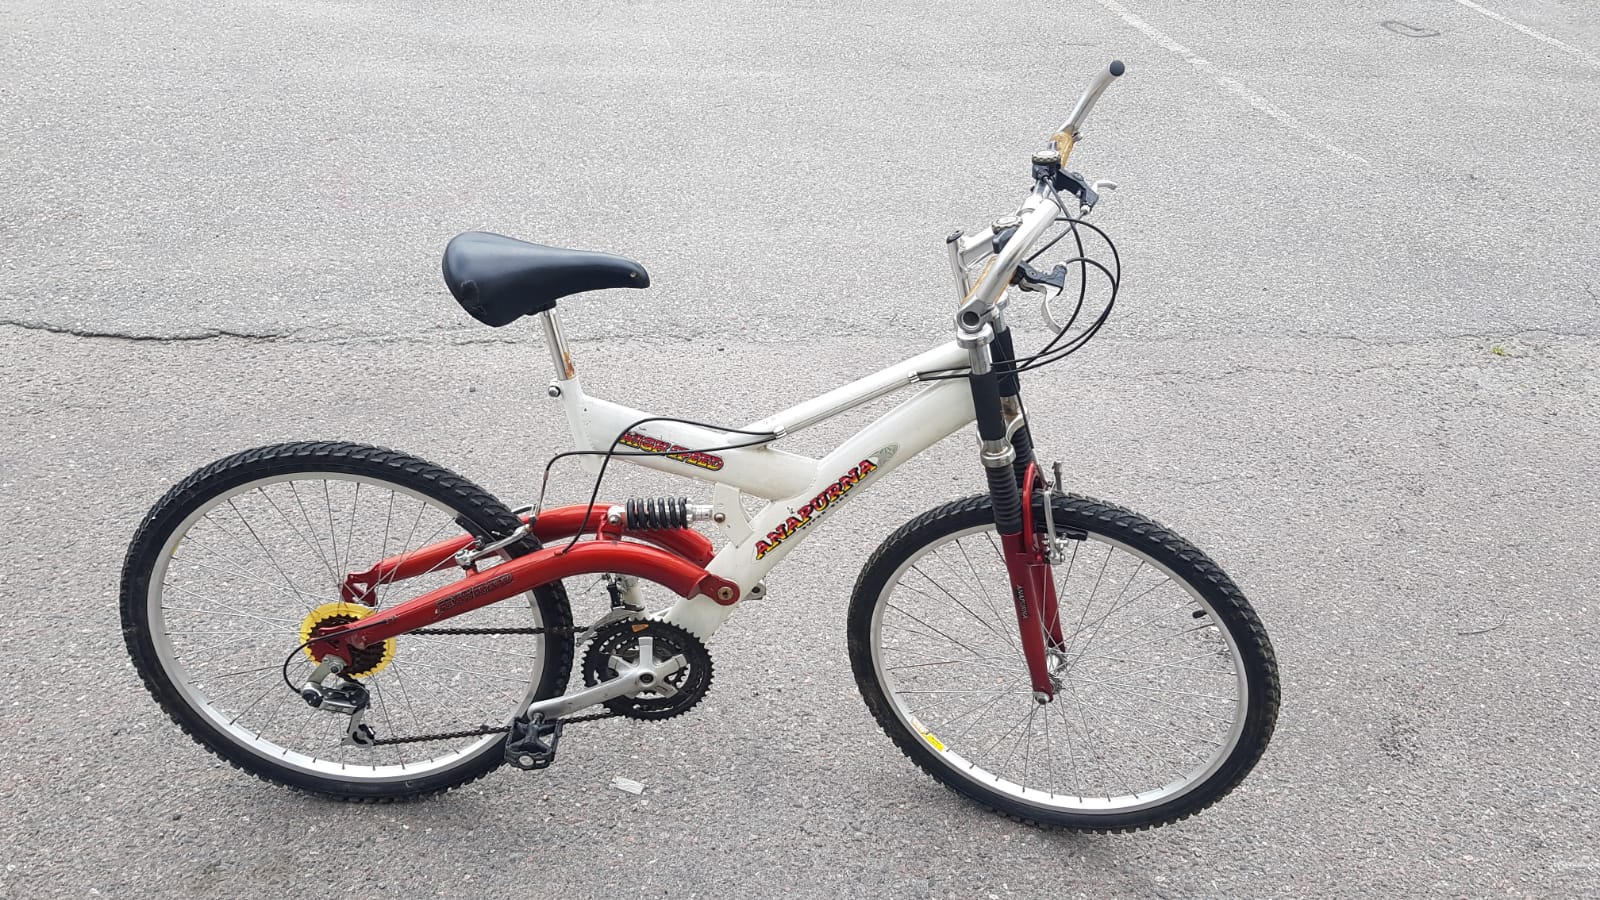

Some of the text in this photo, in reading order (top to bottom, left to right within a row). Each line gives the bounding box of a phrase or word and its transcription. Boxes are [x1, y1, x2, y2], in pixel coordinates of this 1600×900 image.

[619, 431, 724, 471] HIGH SPEED
[755, 458, 878, 560] ANAPURNA
